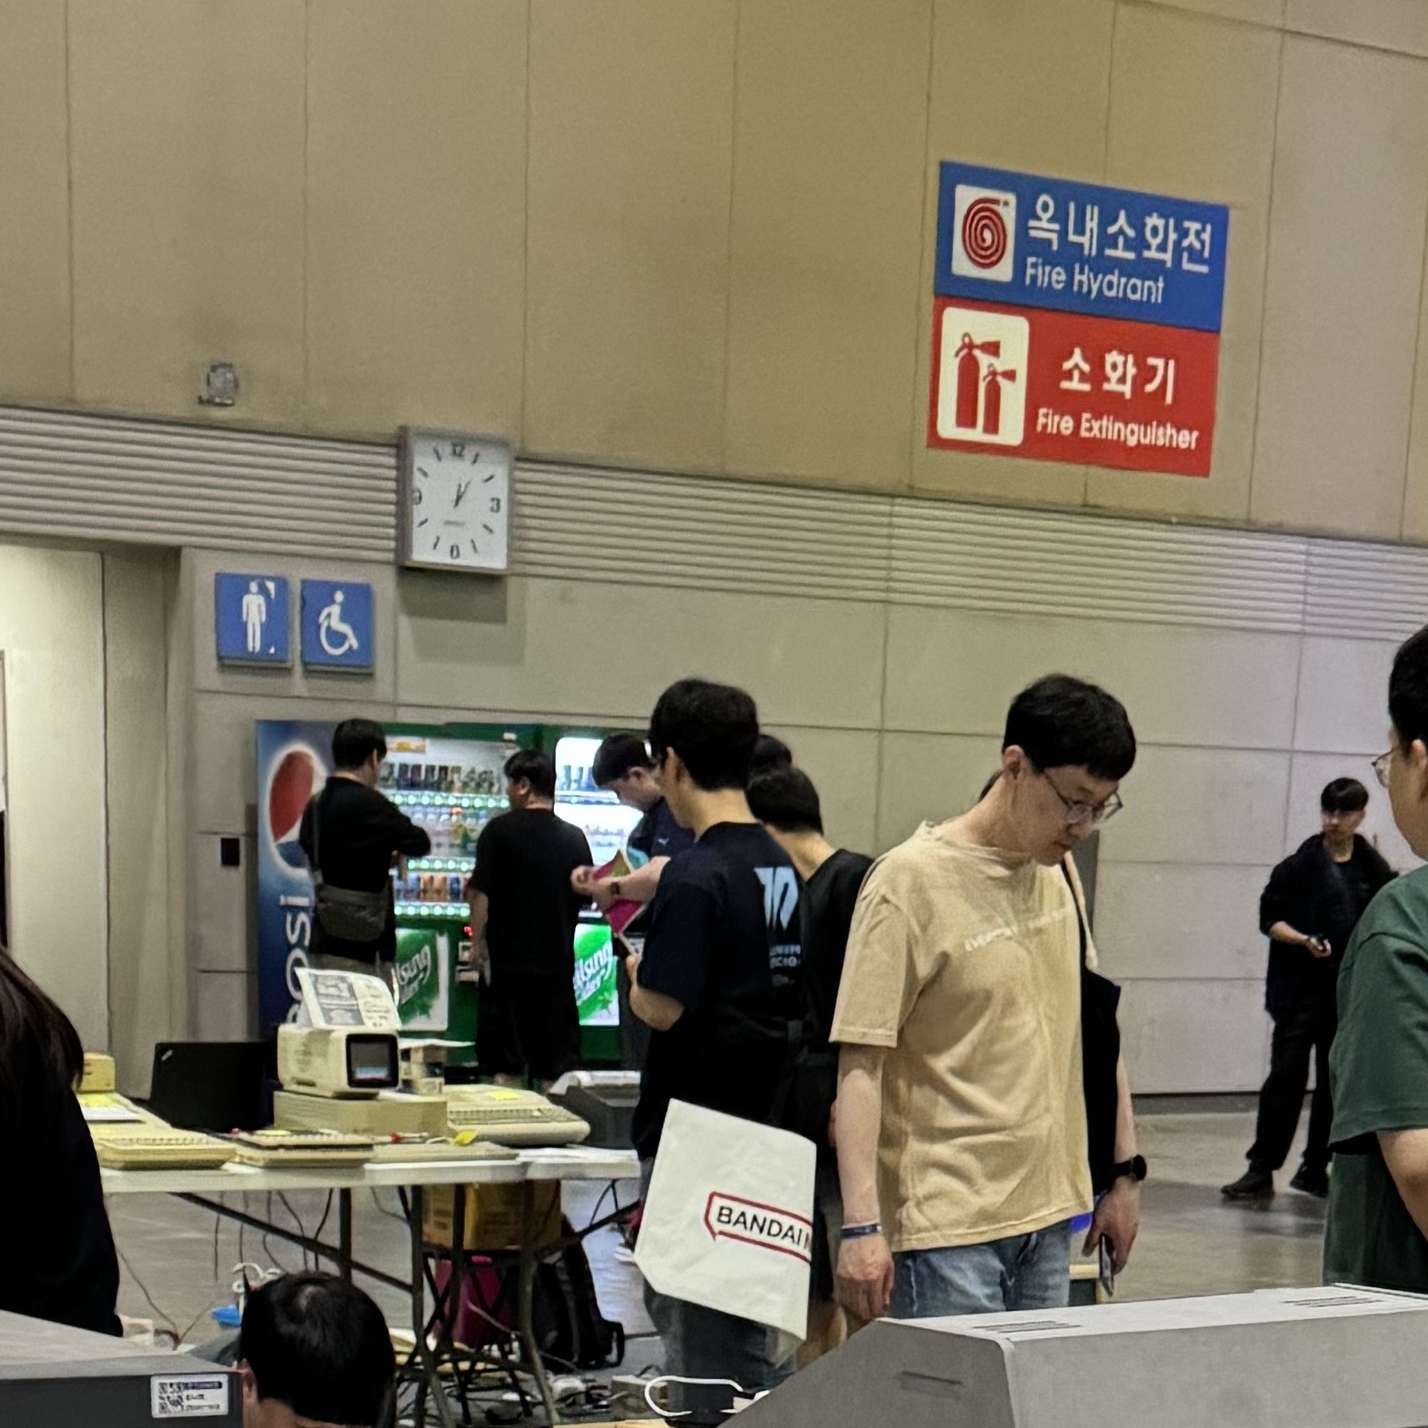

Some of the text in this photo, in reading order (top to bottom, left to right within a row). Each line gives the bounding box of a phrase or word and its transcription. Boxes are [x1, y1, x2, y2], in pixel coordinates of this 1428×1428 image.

[1027, 194, 1213, 274] 옥내소화전
[1025, 257, 1165, 304] Fire Hydrant
[1059, 347, 1176, 406] 소화기
[1036, 407, 1200, 451] Fire Extinguisher
[716, 1204, 804, 1247] BANDAI
